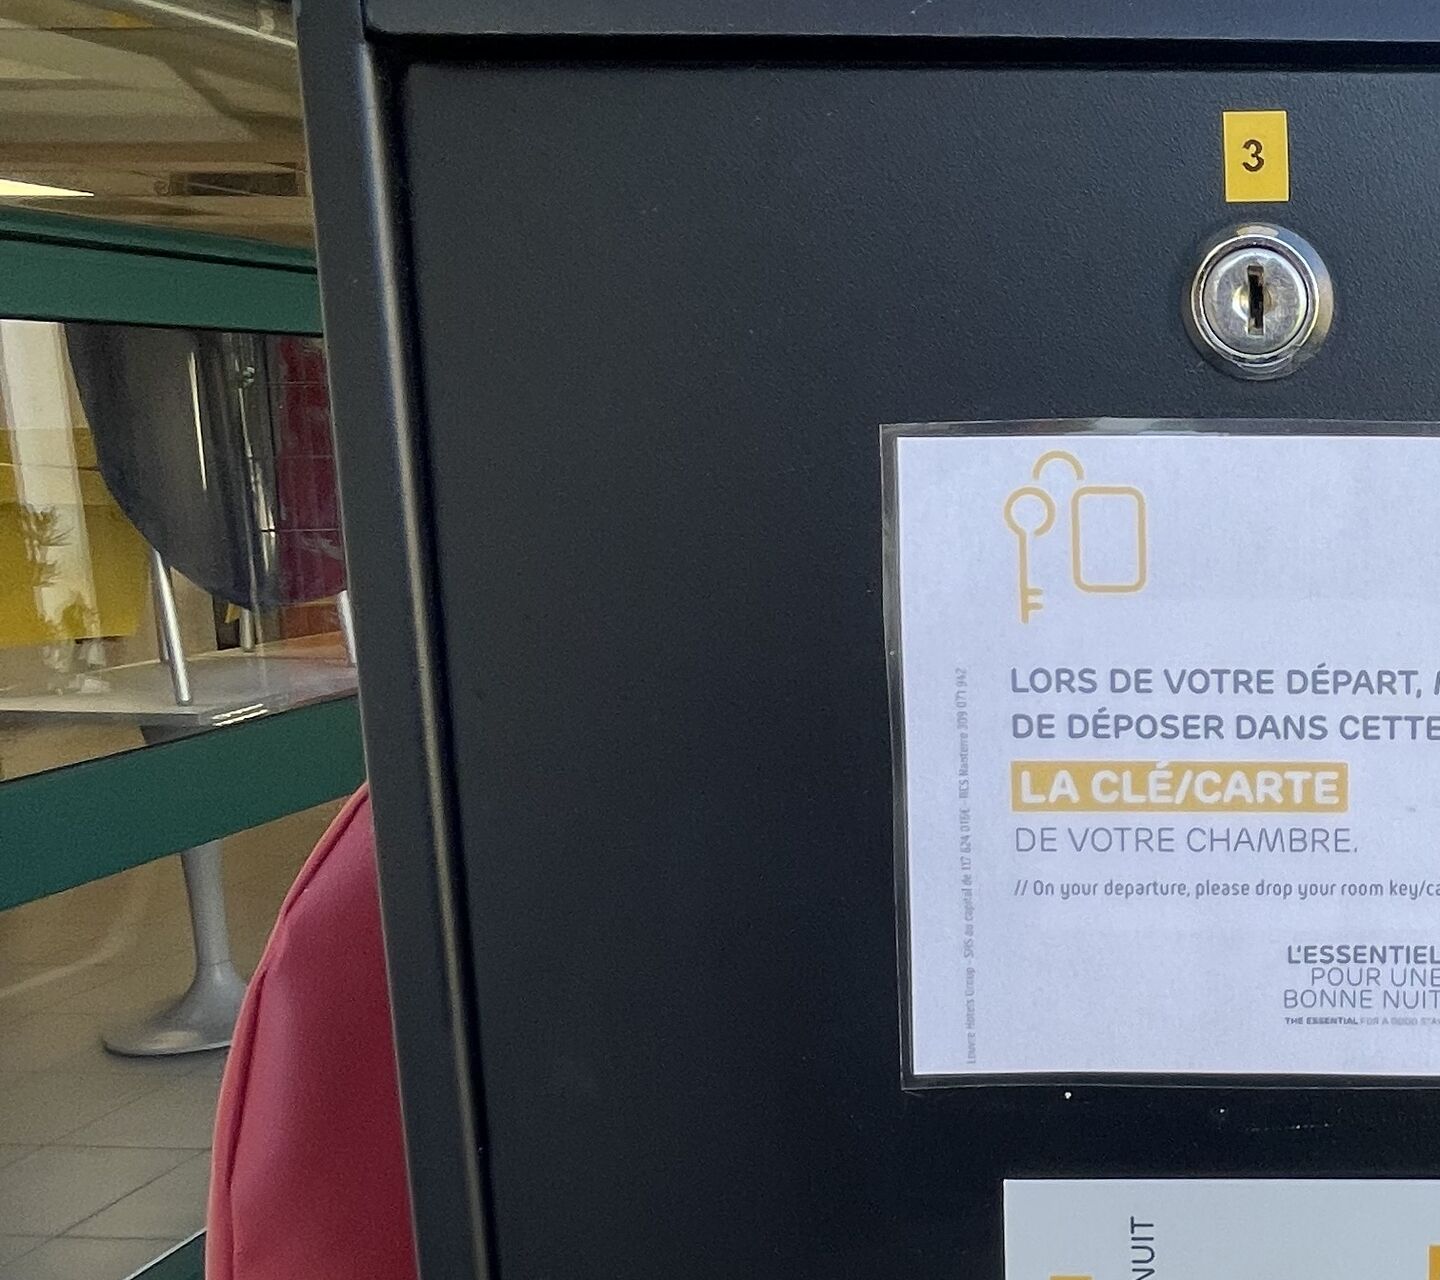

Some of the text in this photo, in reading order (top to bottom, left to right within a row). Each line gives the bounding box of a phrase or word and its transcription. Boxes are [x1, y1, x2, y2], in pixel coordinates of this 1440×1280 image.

[1242, 139, 1265, 172] 3
[1011, 668, 1097, 694] LORS
[1110, 668, 1153, 694] DE
[1164, 669, 1274, 695] VOTRE
[1287, 663, 1422, 698] DÉPART,
[1012, 713, 1056, 739] DE
[1068, 707, 1225, 739] DÉPOSER
[1236, 715, 1328, 740] DANS
[1020, 761, 1339, 805] LA CLÉ/CARTE
[1015, 827, 1358, 853] DE VOTRE CHAMBRE.
[1033, 880, 1054, 896] On
[1061, 882, 1098, 900] your
[1104, 879, 1190, 899] departure,
[1195, 879, 1250, 899] please
[1255, 879, 1293, 899] drop
[1298, 882, 1337, 900] your
[1341, 882, 1384, 897] room
[1311, 967, 1381, 987] POUR
[1284, 989, 1373, 1008] BONNE
[1285, 1016, 1304, 1025] THE
